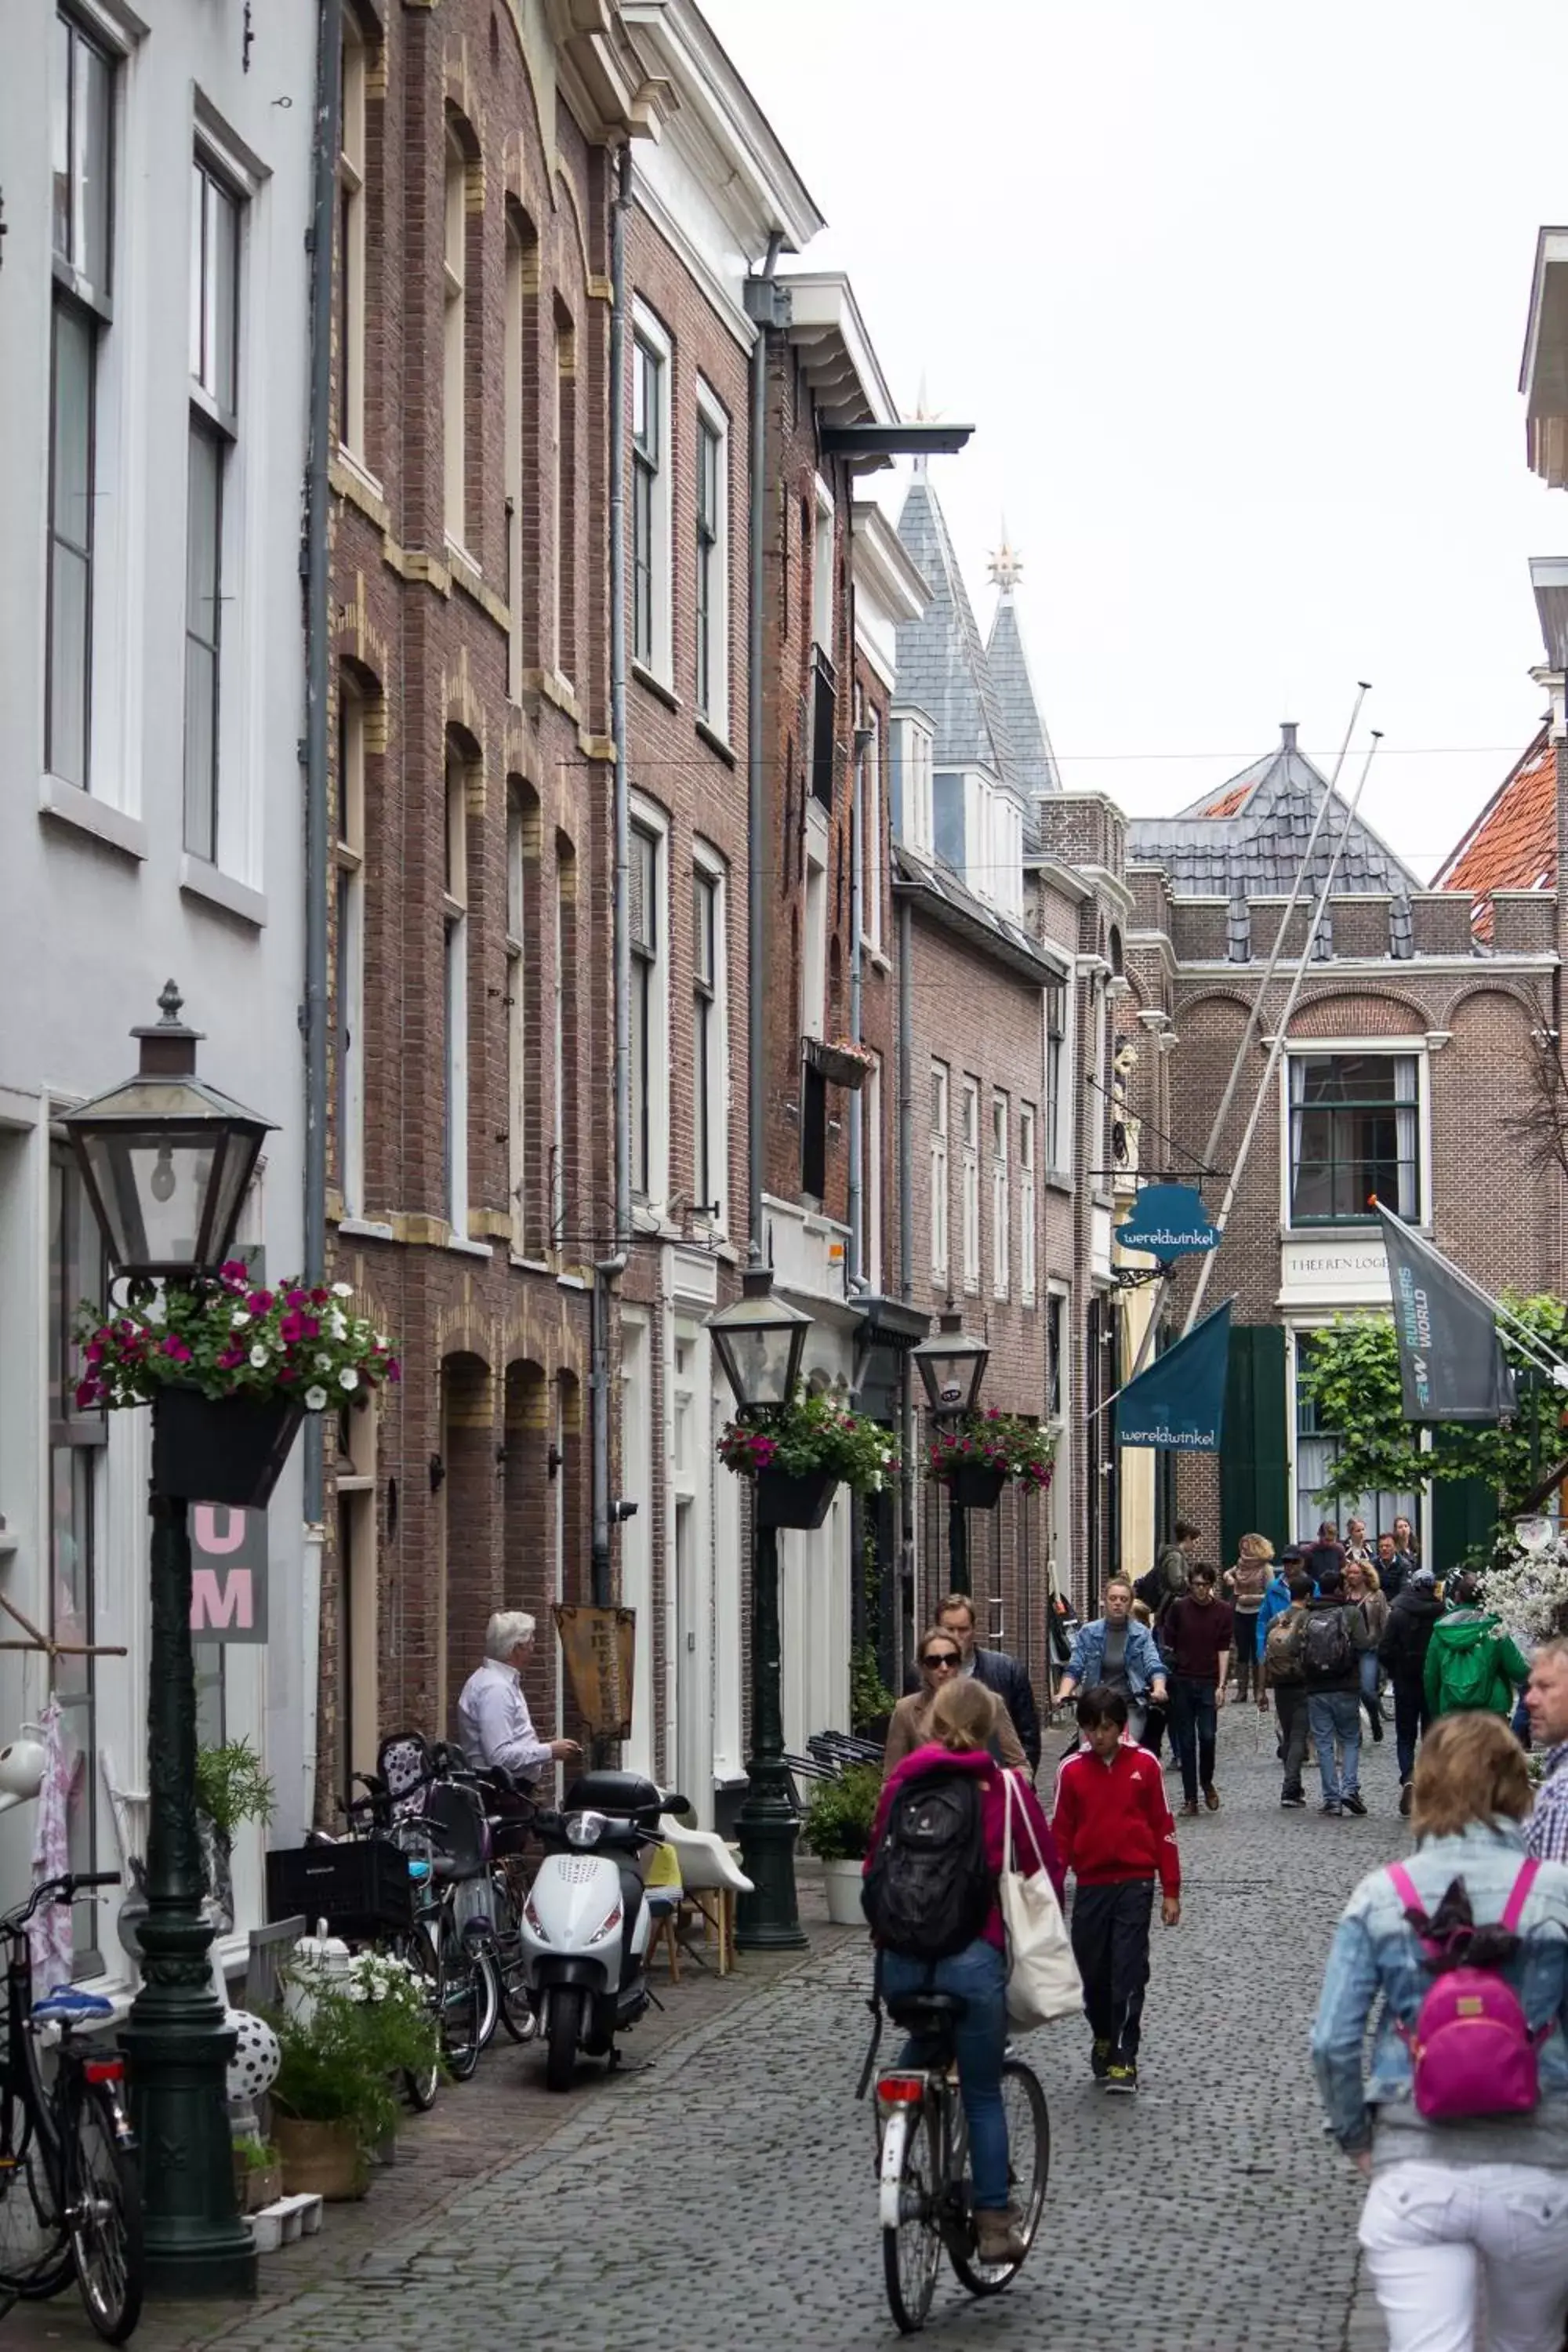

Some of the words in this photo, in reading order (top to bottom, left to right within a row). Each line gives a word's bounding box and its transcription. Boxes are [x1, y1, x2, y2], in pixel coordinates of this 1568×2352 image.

[1123, 1229, 1214, 1245] wereldwinkel
[1399, 1266, 1417, 1349] RUNNERS
[1414, 1289, 1432, 1348] WORLD
[1120, 1426, 1214, 1446] wereldwinkel
